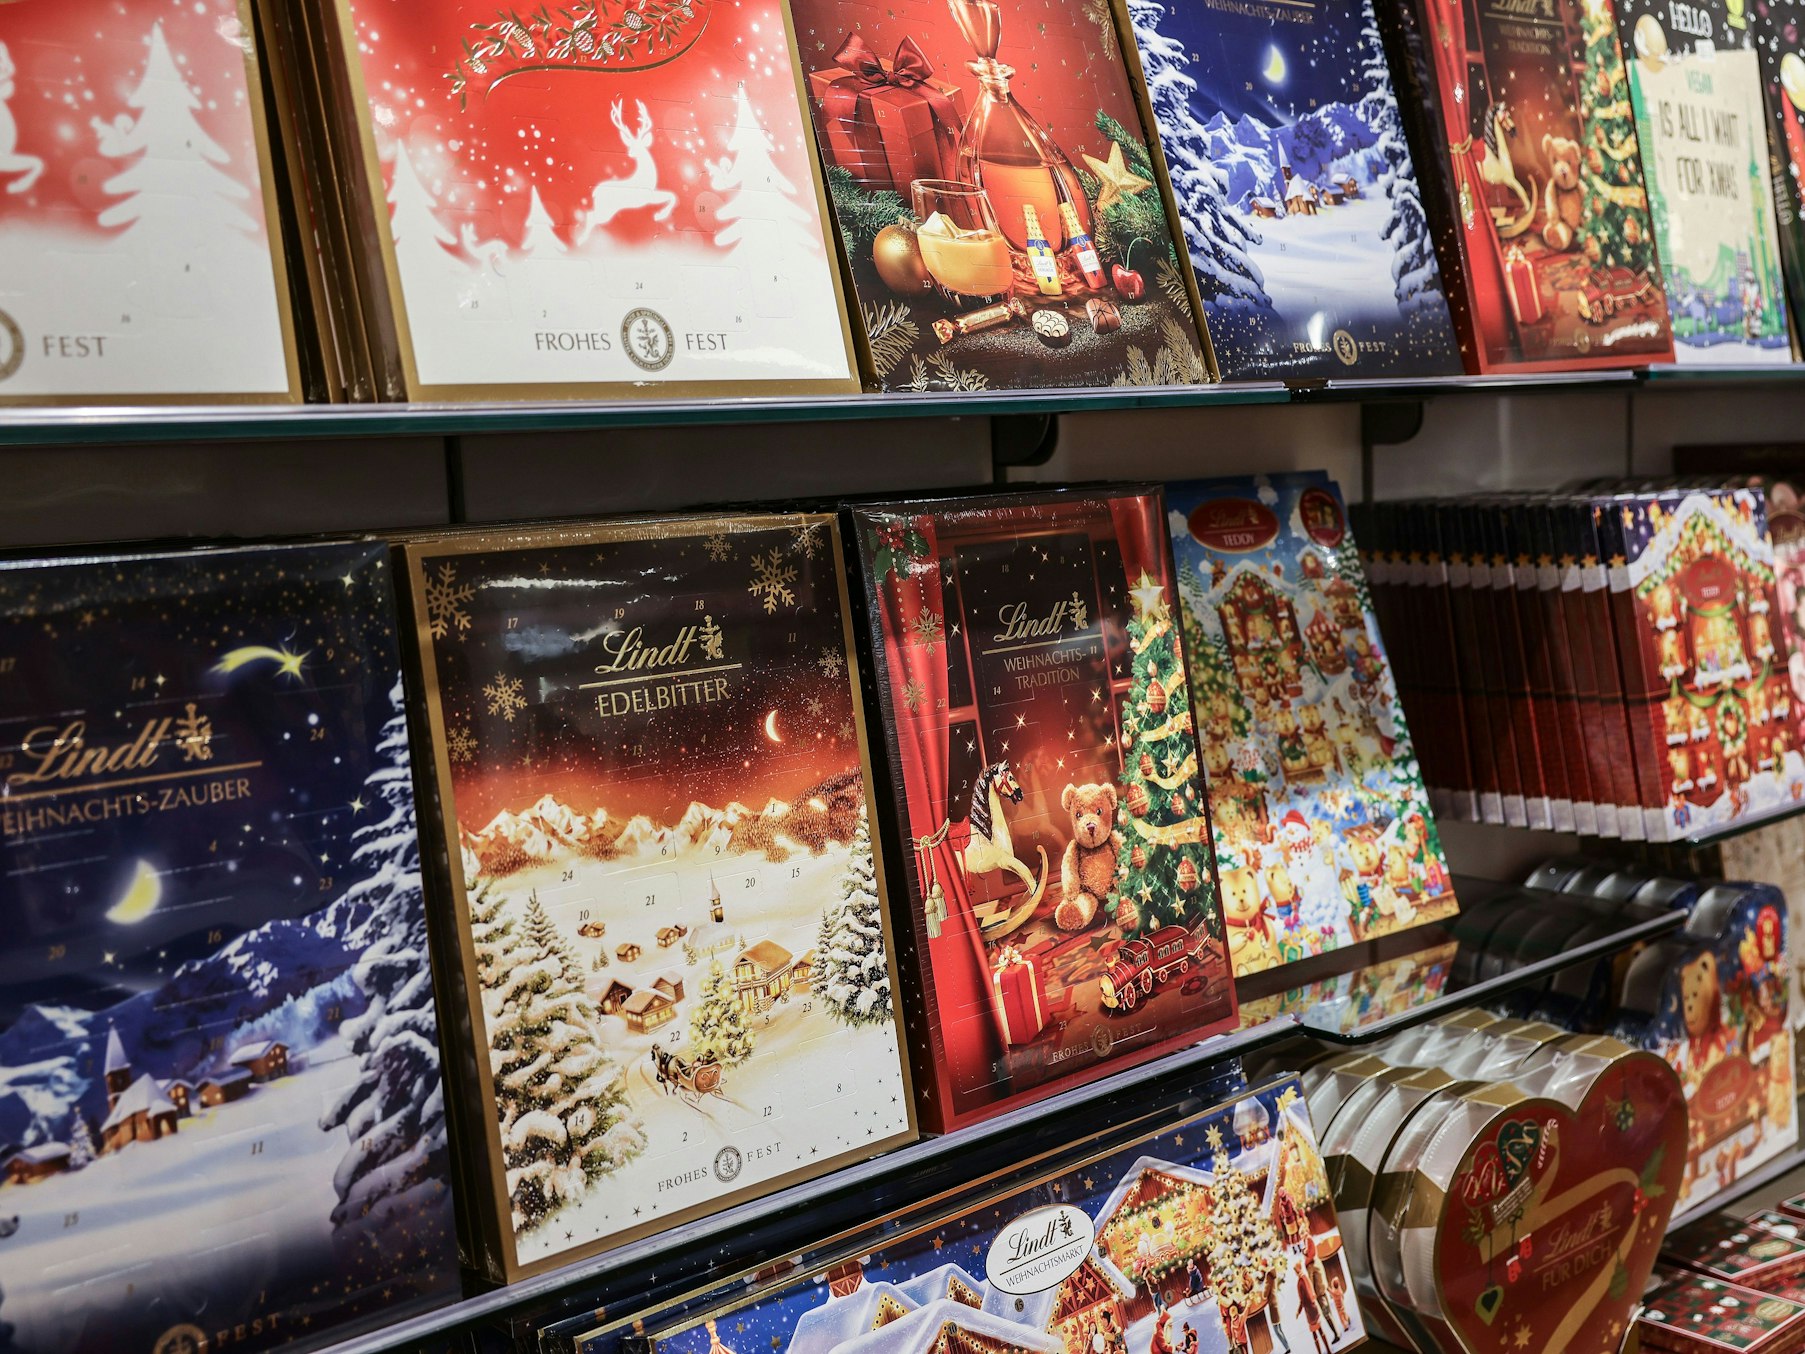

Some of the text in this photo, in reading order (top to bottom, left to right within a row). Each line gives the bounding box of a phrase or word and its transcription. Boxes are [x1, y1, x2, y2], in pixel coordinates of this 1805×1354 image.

[1669, 0, 1713, 38] HELLO
[580, 55, 588, 63] 12
[1192, 53, 1200, 62] 22
[737, 81, 744, 89] 13
[877, 110, 886, 118] 12
[1678, 103, 1701, 142] ALL
[698, 205, 706, 213] 18
[1350, 235, 1357, 243] 11
[1280, 243, 1286, 251] 15
[635, 282, 643, 290] 24
[923, 280, 931, 288] 22
[984, 296, 992, 304] 19
[1128, 292, 1135, 300] 17
[735, 315, 742, 323] 16
[1248, 317, 1256, 326] 19
[43, 335, 107, 358] FEST
[536, 332, 727, 352] FROHES FEST
[1293, 341, 1386, 353] FROES FEST
[1222, 532, 1254, 547] TEDDY
[1001, 563, 1010, 573] 18
[695, 600, 705, 610] 18
[614, 608, 625, 619] 19
[507, 617, 518, 629] 17
[993, 600, 1067, 642] Lindt
[788, 632, 797, 643] 11
[594, 625, 698, 674] Lindt
[1090, 646, 1097, 654] 11
[326, 649, 335, 662] 9
[1004, 647, 1087, 672] WEIHNACHTS-
[131, 677, 146, 690] 14
[1015, 667, 1080, 690] TRADITION
[993, 686, 1001, 695] 14
[598, 677, 731, 718] EDELBITTER
[936, 698, 946, 708] 22
[310, 728, 325, 741] 24
[701, 734, 707, 744] 4
[7, 717, 173, 785] Lindt
[633, 745, 643, 755] 13
[962, 779, 967, 789] 2
[209, 839, 217, 852] 4
[661, 845, 667, 856] 6
[715, 845, 721, 856] 9
[562, 869, 573, 882] 24
[791, 868, 800, 879] 15
[319, 877, 333, 891] 23
[745, 877, 756, 889] 20
[645, 894, 656, 906] 21
[579, 909, 590, 921] 10
[208, 929, 222, 944] 16
[988, 941, 997, 950] 16
[802, 1002, 812, 1013] 23
[596, 1013, 602, 1024] 3
[764, 1014, 770, 1025] 5
[1058, 1021, 1067, 1031] 23
[670, 1031, 681, 1043] 22
[1052, 1022, 1142, 1062] FROHES FEST
[991, 1062, 997, 1073] 5
[836, 1083, 842, 1093] 8
[763, 1106, 772, 1118] 12
[575, 1114, 585, 1126] 14
[682, 1131, 688, 1142] 2
[251, 1141, 263, 1155] 11
[657, 1141, 781, 1192] FROHES FEST
[1006, 1219, 1058, 1264] Lindt
[1542, 1210, 1600, 1262] Lindt
[1574, 1239, 1612, 1275] DICH
[1005, 1244, 1084, 1287] WEIHNACHTSMARKT
[1015, 1300, 1023, 1310] 15
[216, 1312, 280, 1347] FEST
